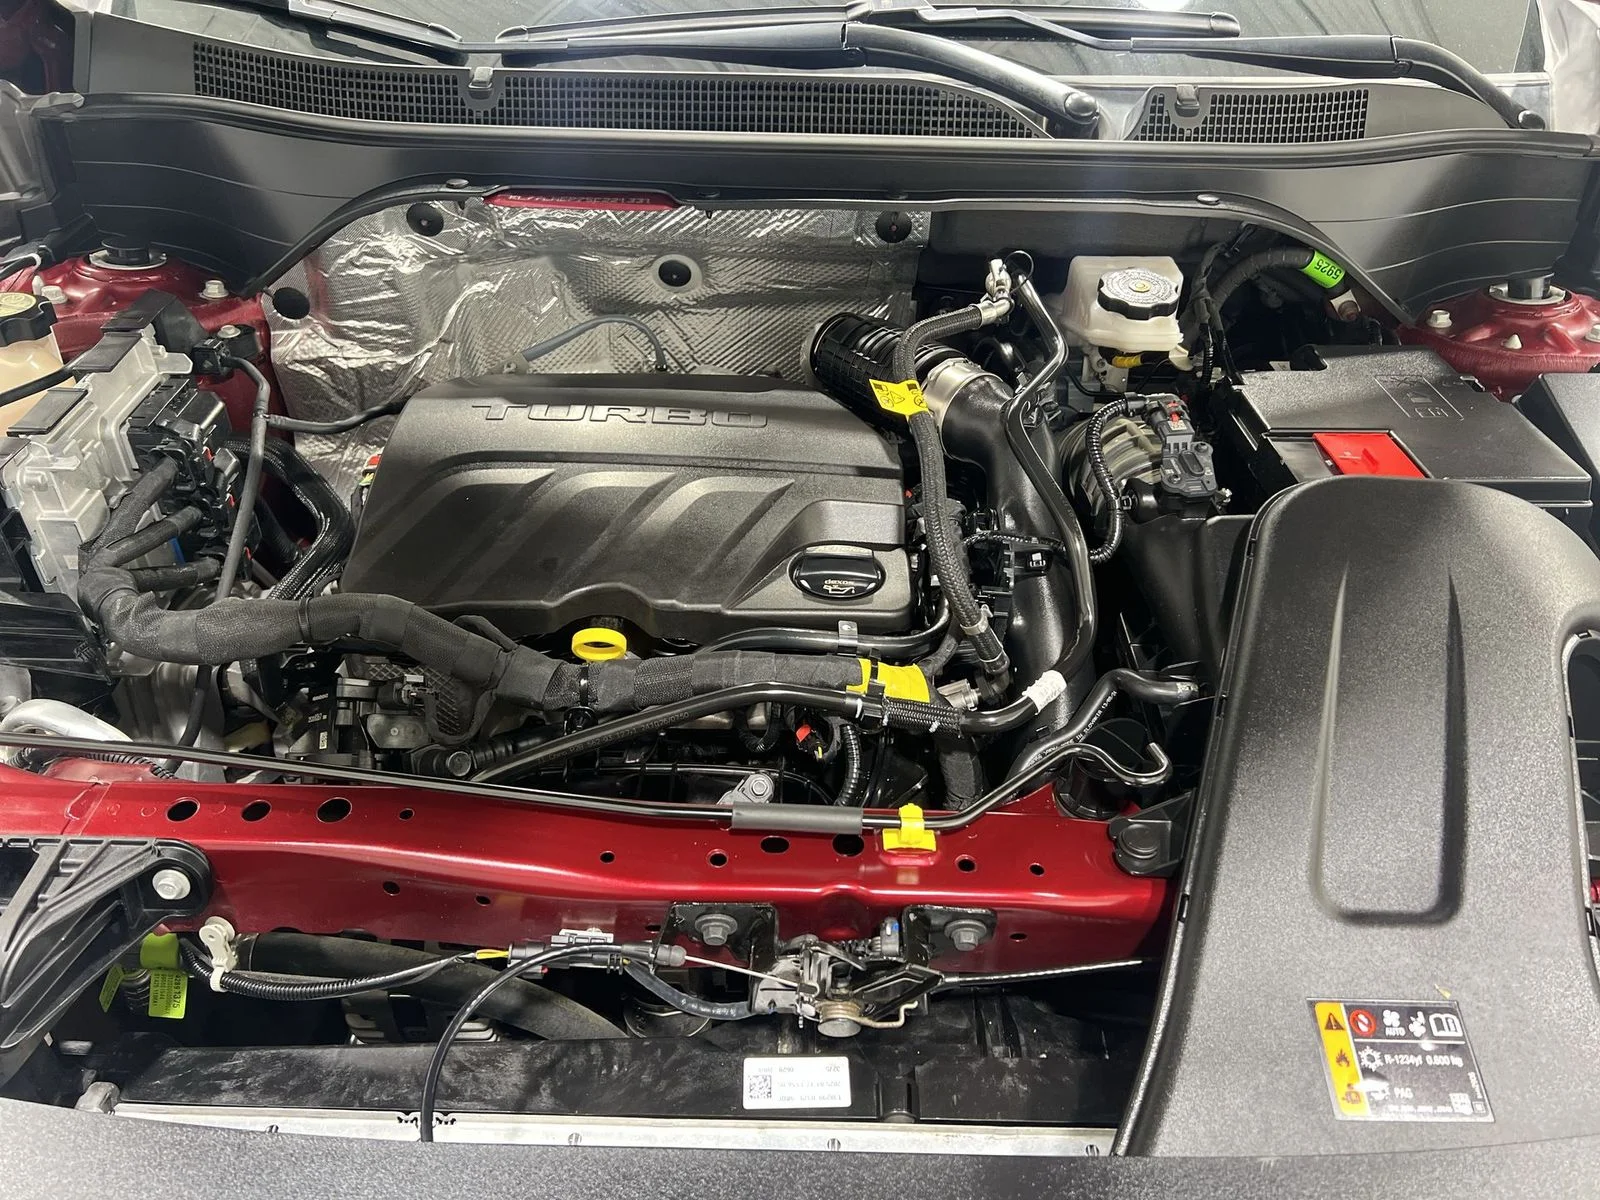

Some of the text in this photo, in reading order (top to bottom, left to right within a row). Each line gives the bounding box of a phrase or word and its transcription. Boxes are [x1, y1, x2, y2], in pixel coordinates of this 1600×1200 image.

[1314, 258, 1342, 280] 5925
[472, 403, 768, 429] TURBO
[1385, 1027, 1406, 1037] AUTO
[1384, 1054, 1423, 1067] R-1234yf
[1393, 1087, 1413, 1099] PAG
